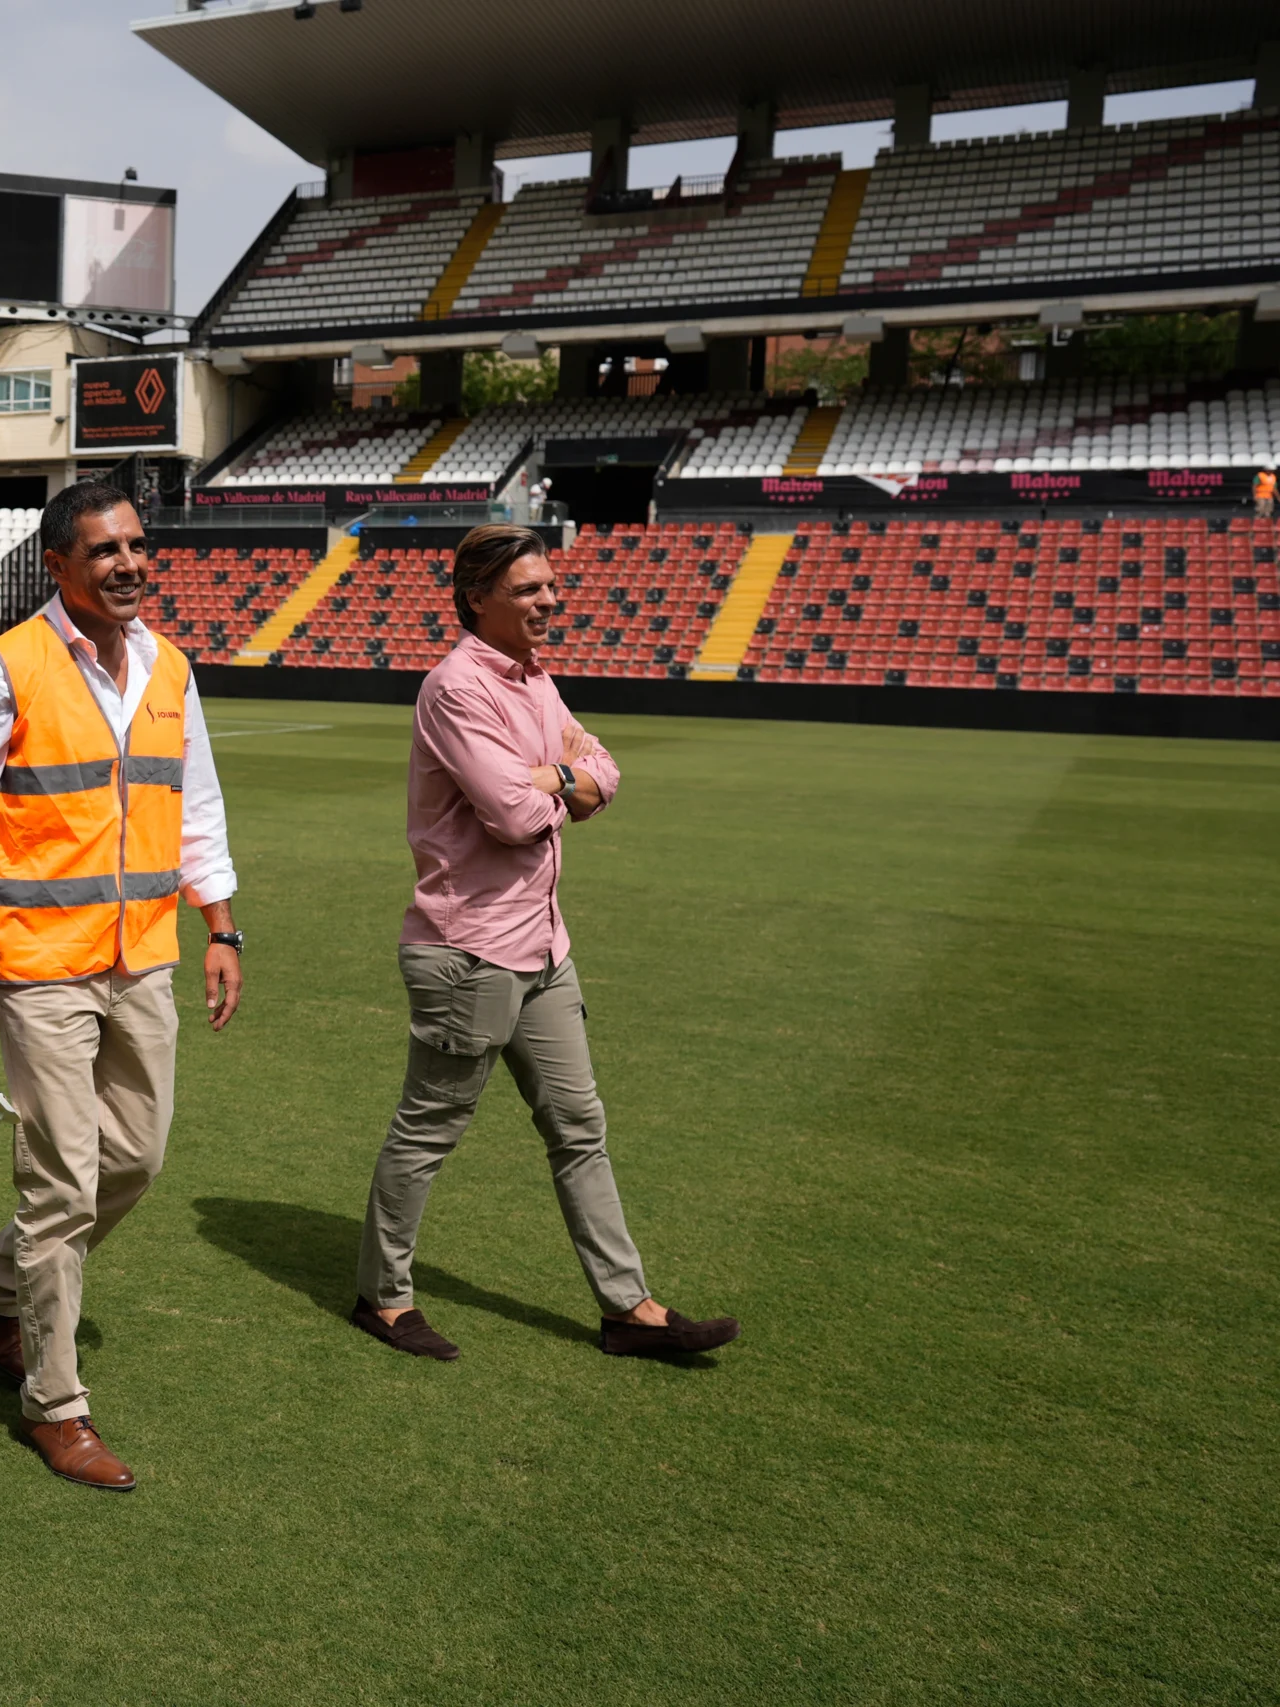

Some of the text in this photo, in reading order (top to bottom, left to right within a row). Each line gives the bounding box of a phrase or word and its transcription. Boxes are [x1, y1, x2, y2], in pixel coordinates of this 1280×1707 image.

[761, 477, 824, 493] Mahou
[1010, 472, 1081, 489] Mahou
[1147, 468, 1224, 488] Mahou
[195, 490, 326, 507] Rayo Vallecano de Madrid
[345, 487, 488, 504] Rayo Vallecano de Madrid
